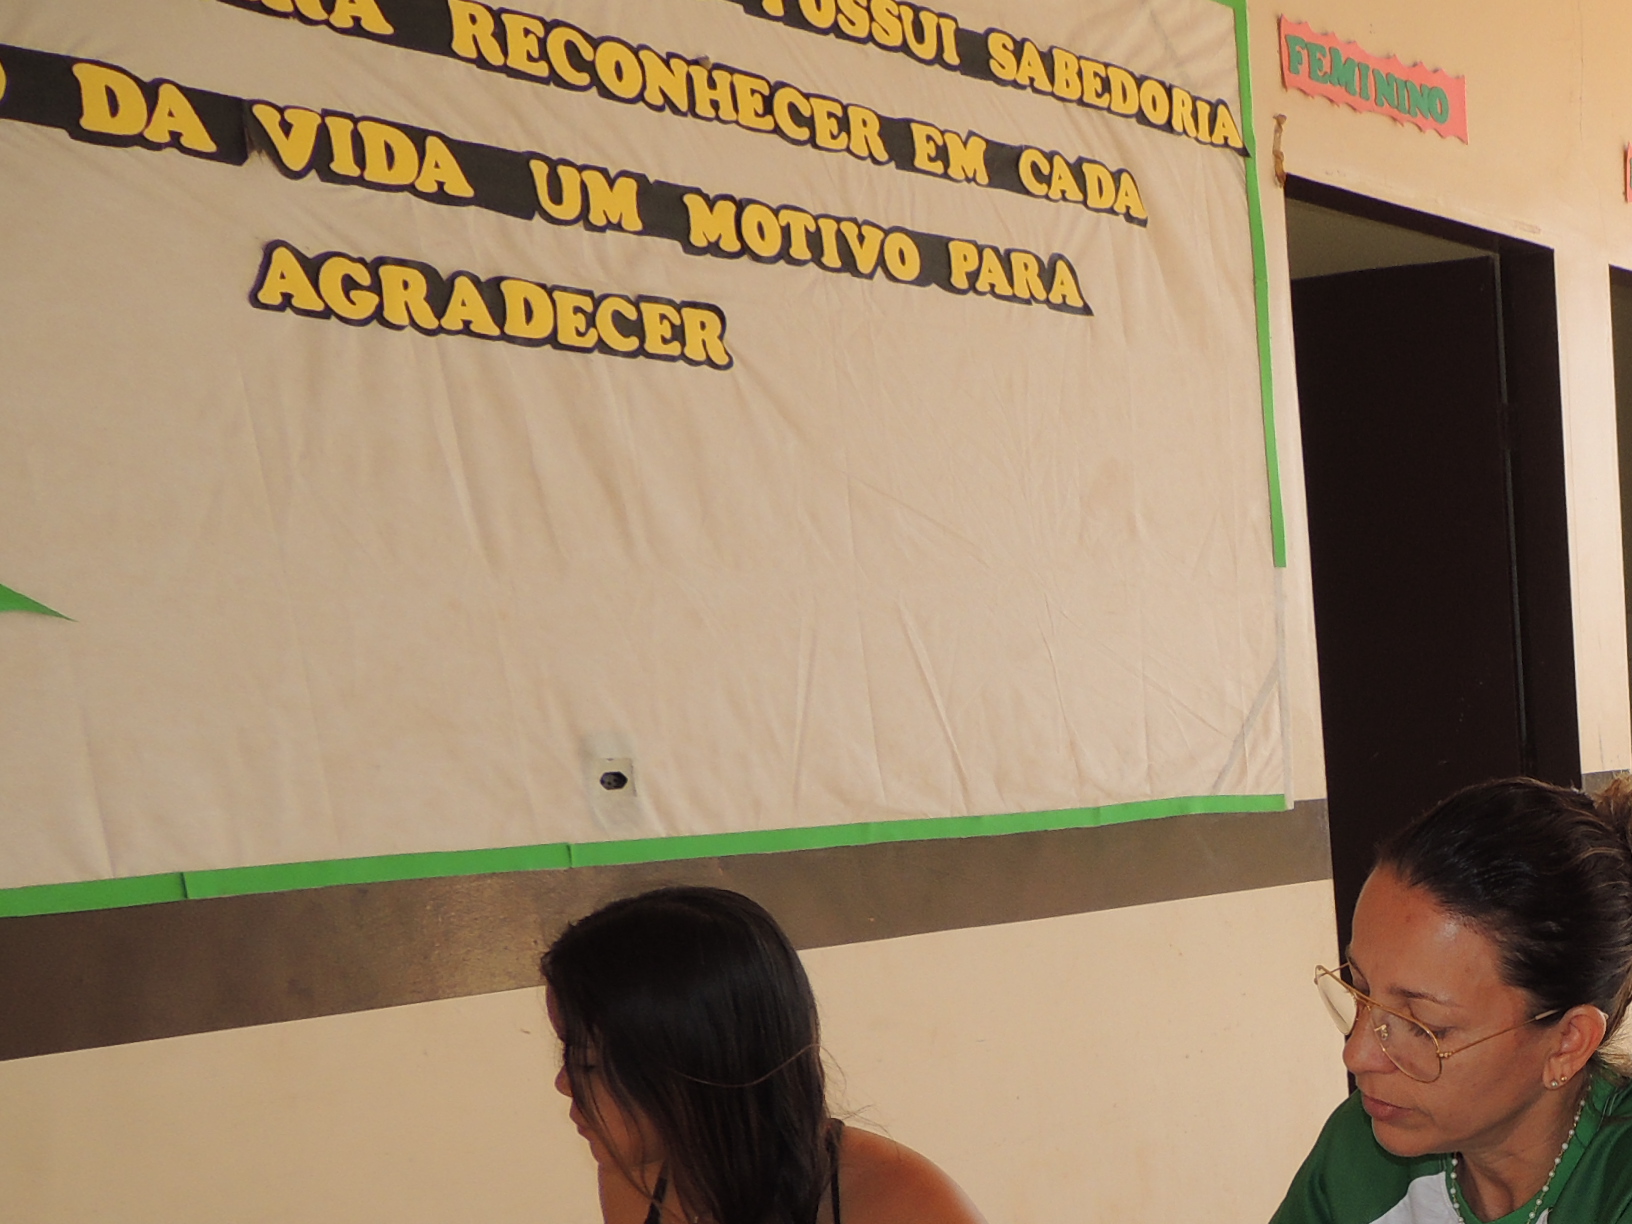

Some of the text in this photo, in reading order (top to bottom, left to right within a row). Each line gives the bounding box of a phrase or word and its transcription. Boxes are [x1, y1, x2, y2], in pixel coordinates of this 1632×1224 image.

[450, 0, 888, 161] RECONHECER
[912, 123, 989, 185] EM
[1019, 148, 1147, 219] CADA
[762, 0, 1244, 147] OSSUI SABEDORIA
[1285, 34, 1450, 125] FEMININO
[73, 63, 217, 152] DA
[252, 104, 474, 198] VIDA
[530, 159, 643, 232] UM
[684, 193, 921, 282] MOTIVO
[949, 239, 1085, 308] PARA
[256, 246, 730, 365] AGRADECER
